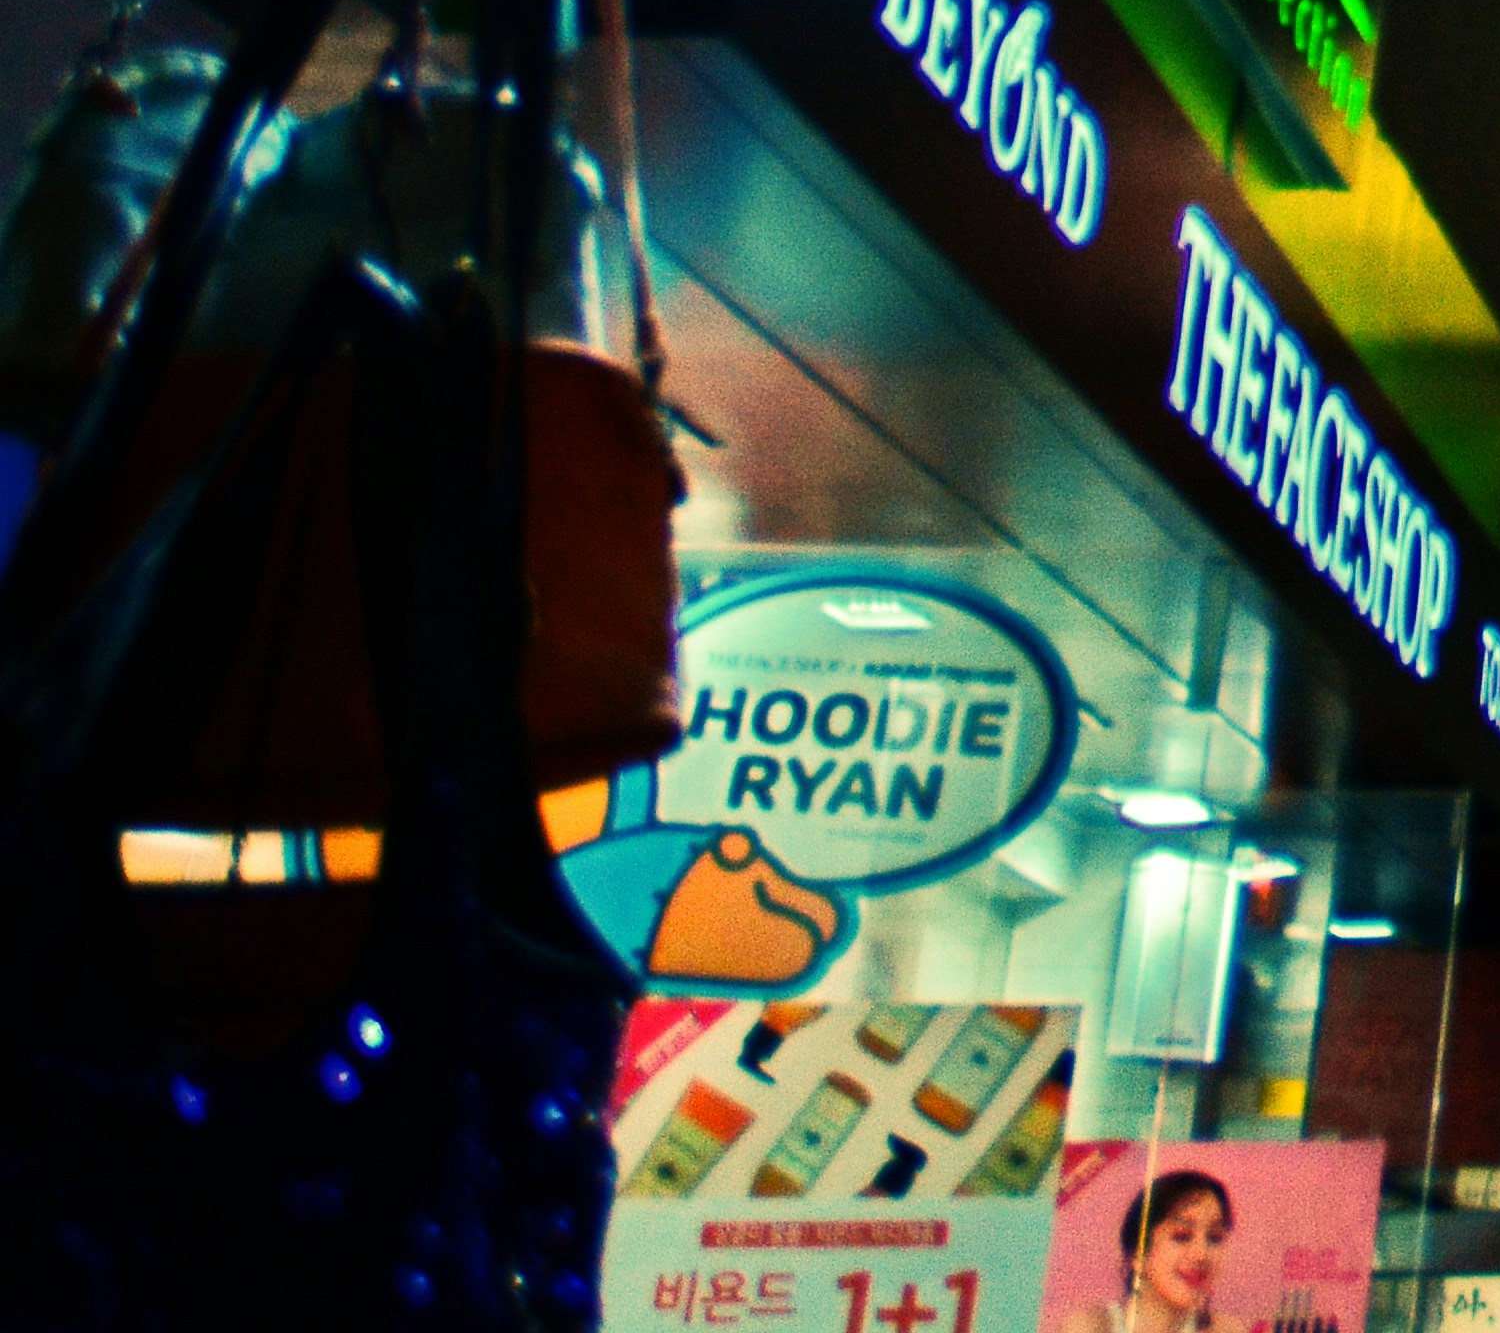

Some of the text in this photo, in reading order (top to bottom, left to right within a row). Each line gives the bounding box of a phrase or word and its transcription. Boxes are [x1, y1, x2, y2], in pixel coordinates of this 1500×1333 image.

[687, 686, 1010, 757] HOODIE
[726, 754, 945, 822] RYAN
[836, 1266, 981, 1333] 1+1
